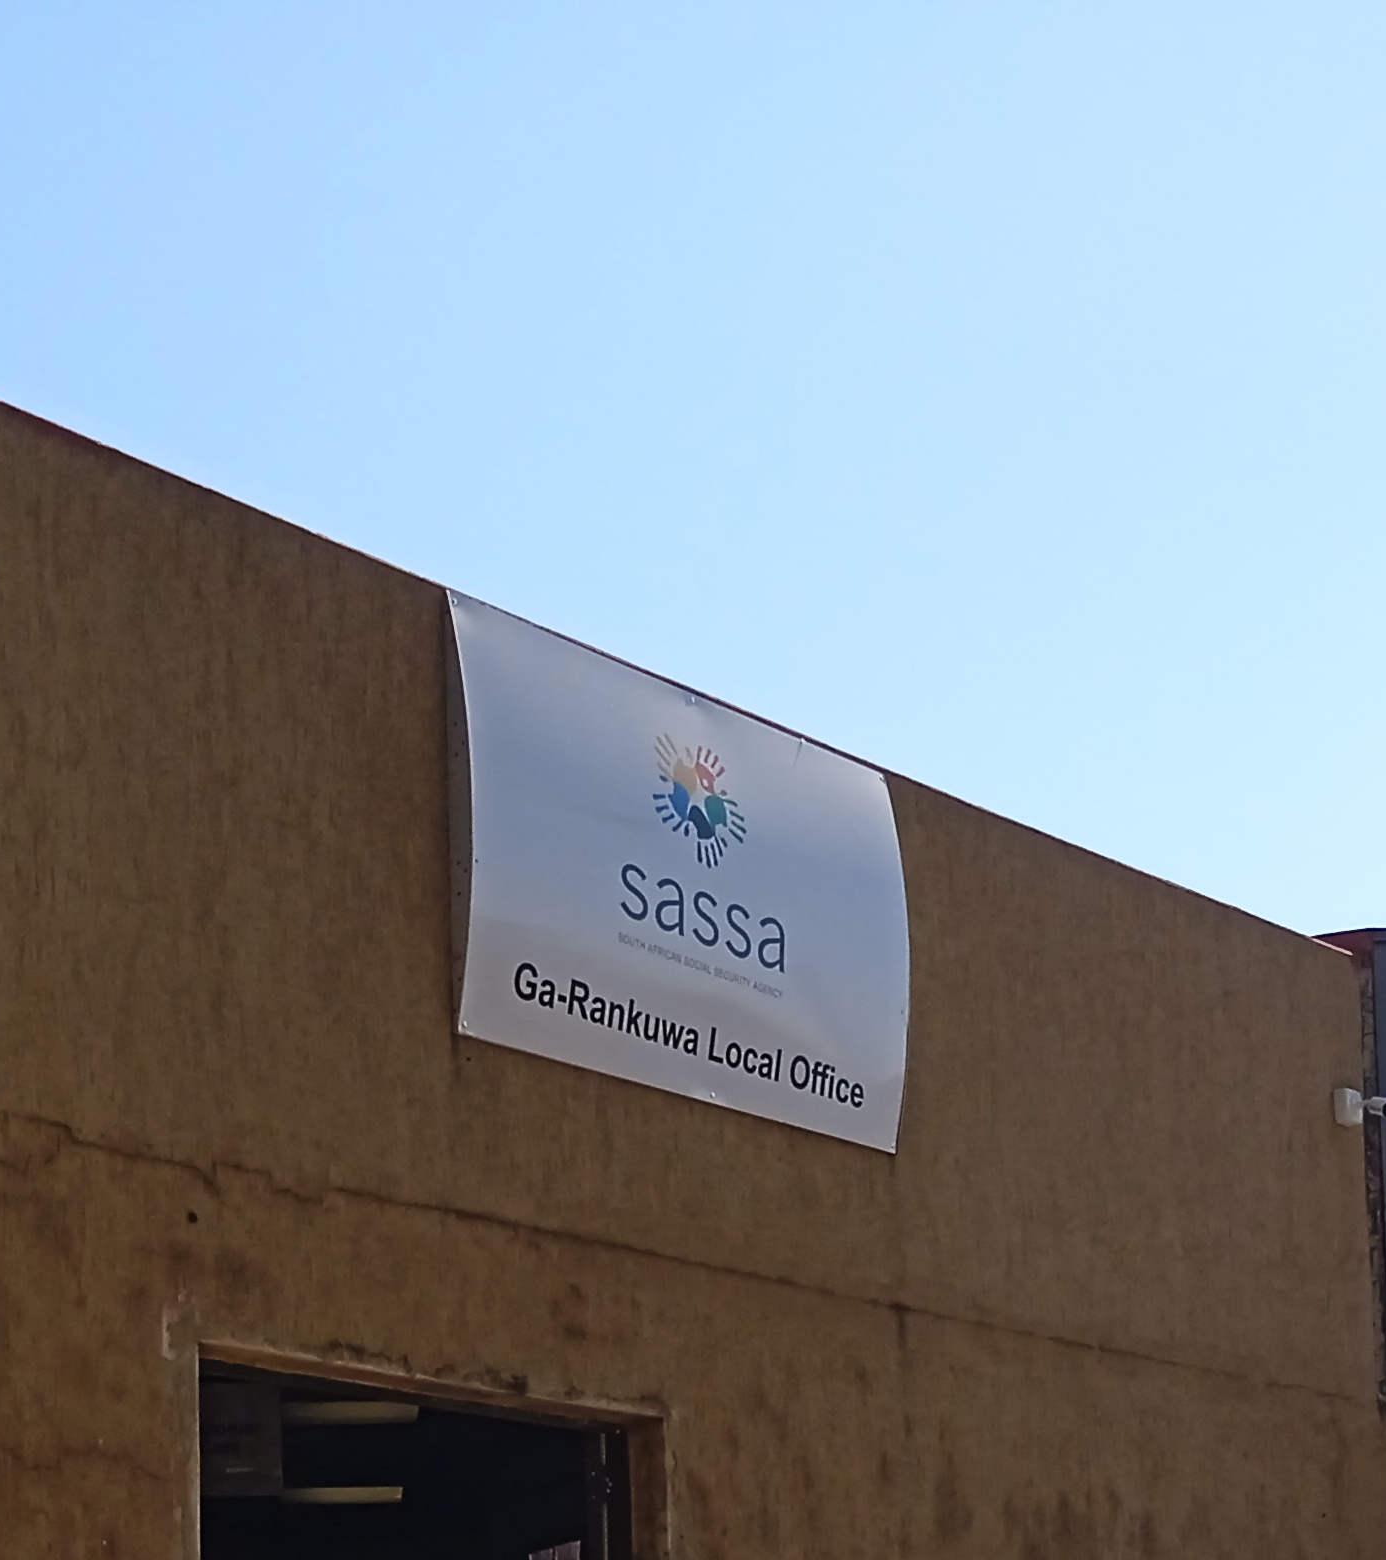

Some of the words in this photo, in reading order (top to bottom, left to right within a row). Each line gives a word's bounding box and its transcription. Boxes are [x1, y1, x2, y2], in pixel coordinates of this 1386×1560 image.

[618, 932, 646, 950] SOUTH
[647, 943, 682, 964] AFRICAN
[683, 955, 712, 975] SOCIAL
[713, 965, 752, 987] SECURITY
[752, 981, 784, 998] AGENCY
[619, 863, 786, 973] sassa
[513, 962, 698, 1057] Ga-Rankuwa
[707, 1025, 782, 1083] Local
[789, 1055, 865, 1109] Office
